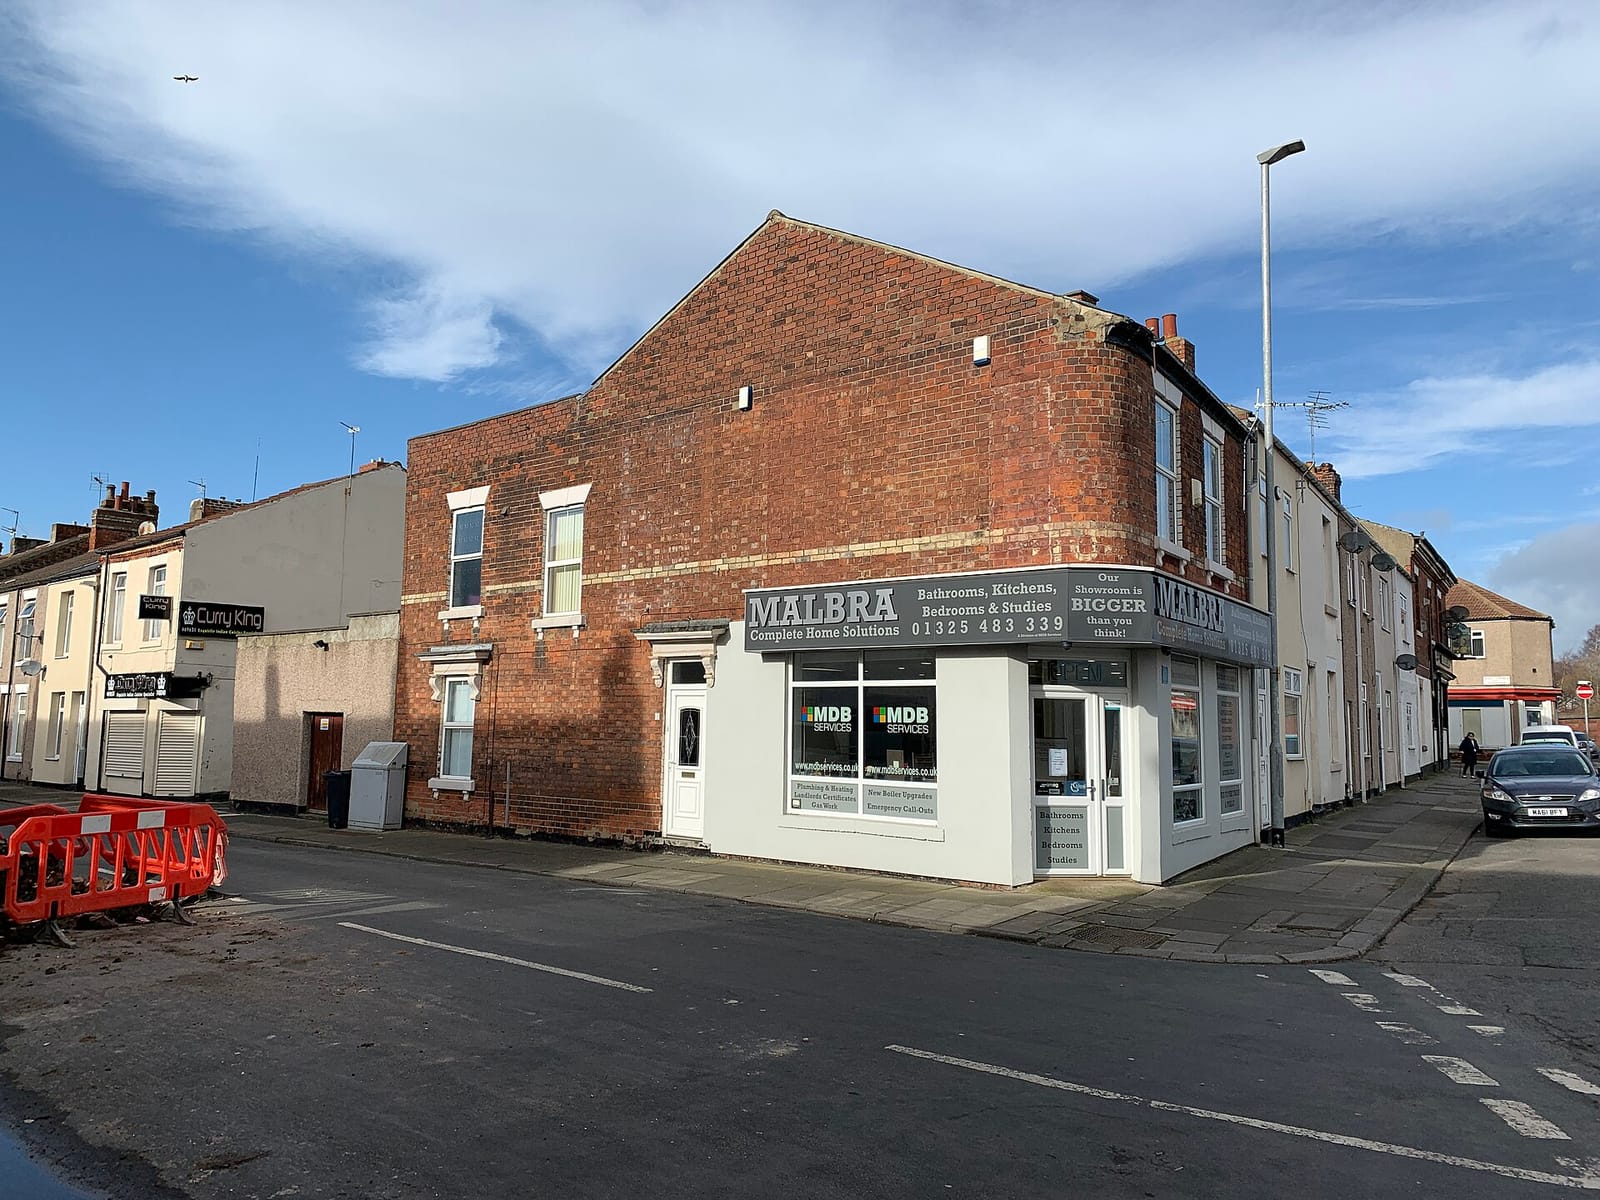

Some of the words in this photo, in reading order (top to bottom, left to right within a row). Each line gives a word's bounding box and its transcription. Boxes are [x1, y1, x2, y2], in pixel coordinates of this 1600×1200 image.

[1098, 573, 1119, 582] Our
[917, 586, 989, 601] Bathrooms,
[991, 582, 1057, 596] Kitchens,
[1075, 585, 1130, 595] Showroom
[1132, 586, 1143, 595] is
[749, 588, 899, 628] MALBRA
[922, 604, 985, 618] Bedrooms
[988, 603, 999, 615] &
[1001, 601, 1052, 614] Studies
[1071, 598, 1147, 613] BIGGER
[1155, 577, 1225, 633] MALBRA
[197, 607, 232, 628] Curry
[234, 609, 262, 630] King
[1087, 616, 1113, 625] than
[1113, 618, 1132, 627] you
[912, 620, 969, 636] 01325
[979, 618, 1015, 633] 483
[1026, 616, 1064, 631] 339
[750, 629, 803, 642] Complete
[806, 627, 840, 639] Home
[843, 625, 900, 638] Solutions
[1094, 629, 1126, 638] think!
[814, 706, 852, 722] MDB
[887, 707, 929, 724] MDB
[814, 722, 852, 733] SERVICES
[887, 724, 929, 735] SERVICES
[796, 783, 824, 793] Plumbing
[830, 785, 854, 794] Heating
[823, 793, 857, 803] Certificates
[868, 789, 881, 797] New
[882, 790, 902, 799] Boiler
[902, 791, 933, 801] Upgrades
[867, 803, 902, 813] Emergency
[903, 805, 934, 815] Call-Outs
[1039, 811, 1084, 820] Bathrooms
[1043, 826, 1080, 834] Kitchens
[1041, 841, 1083, 849] Bedrooms
[1047, 856, 1078, 864] Studies
